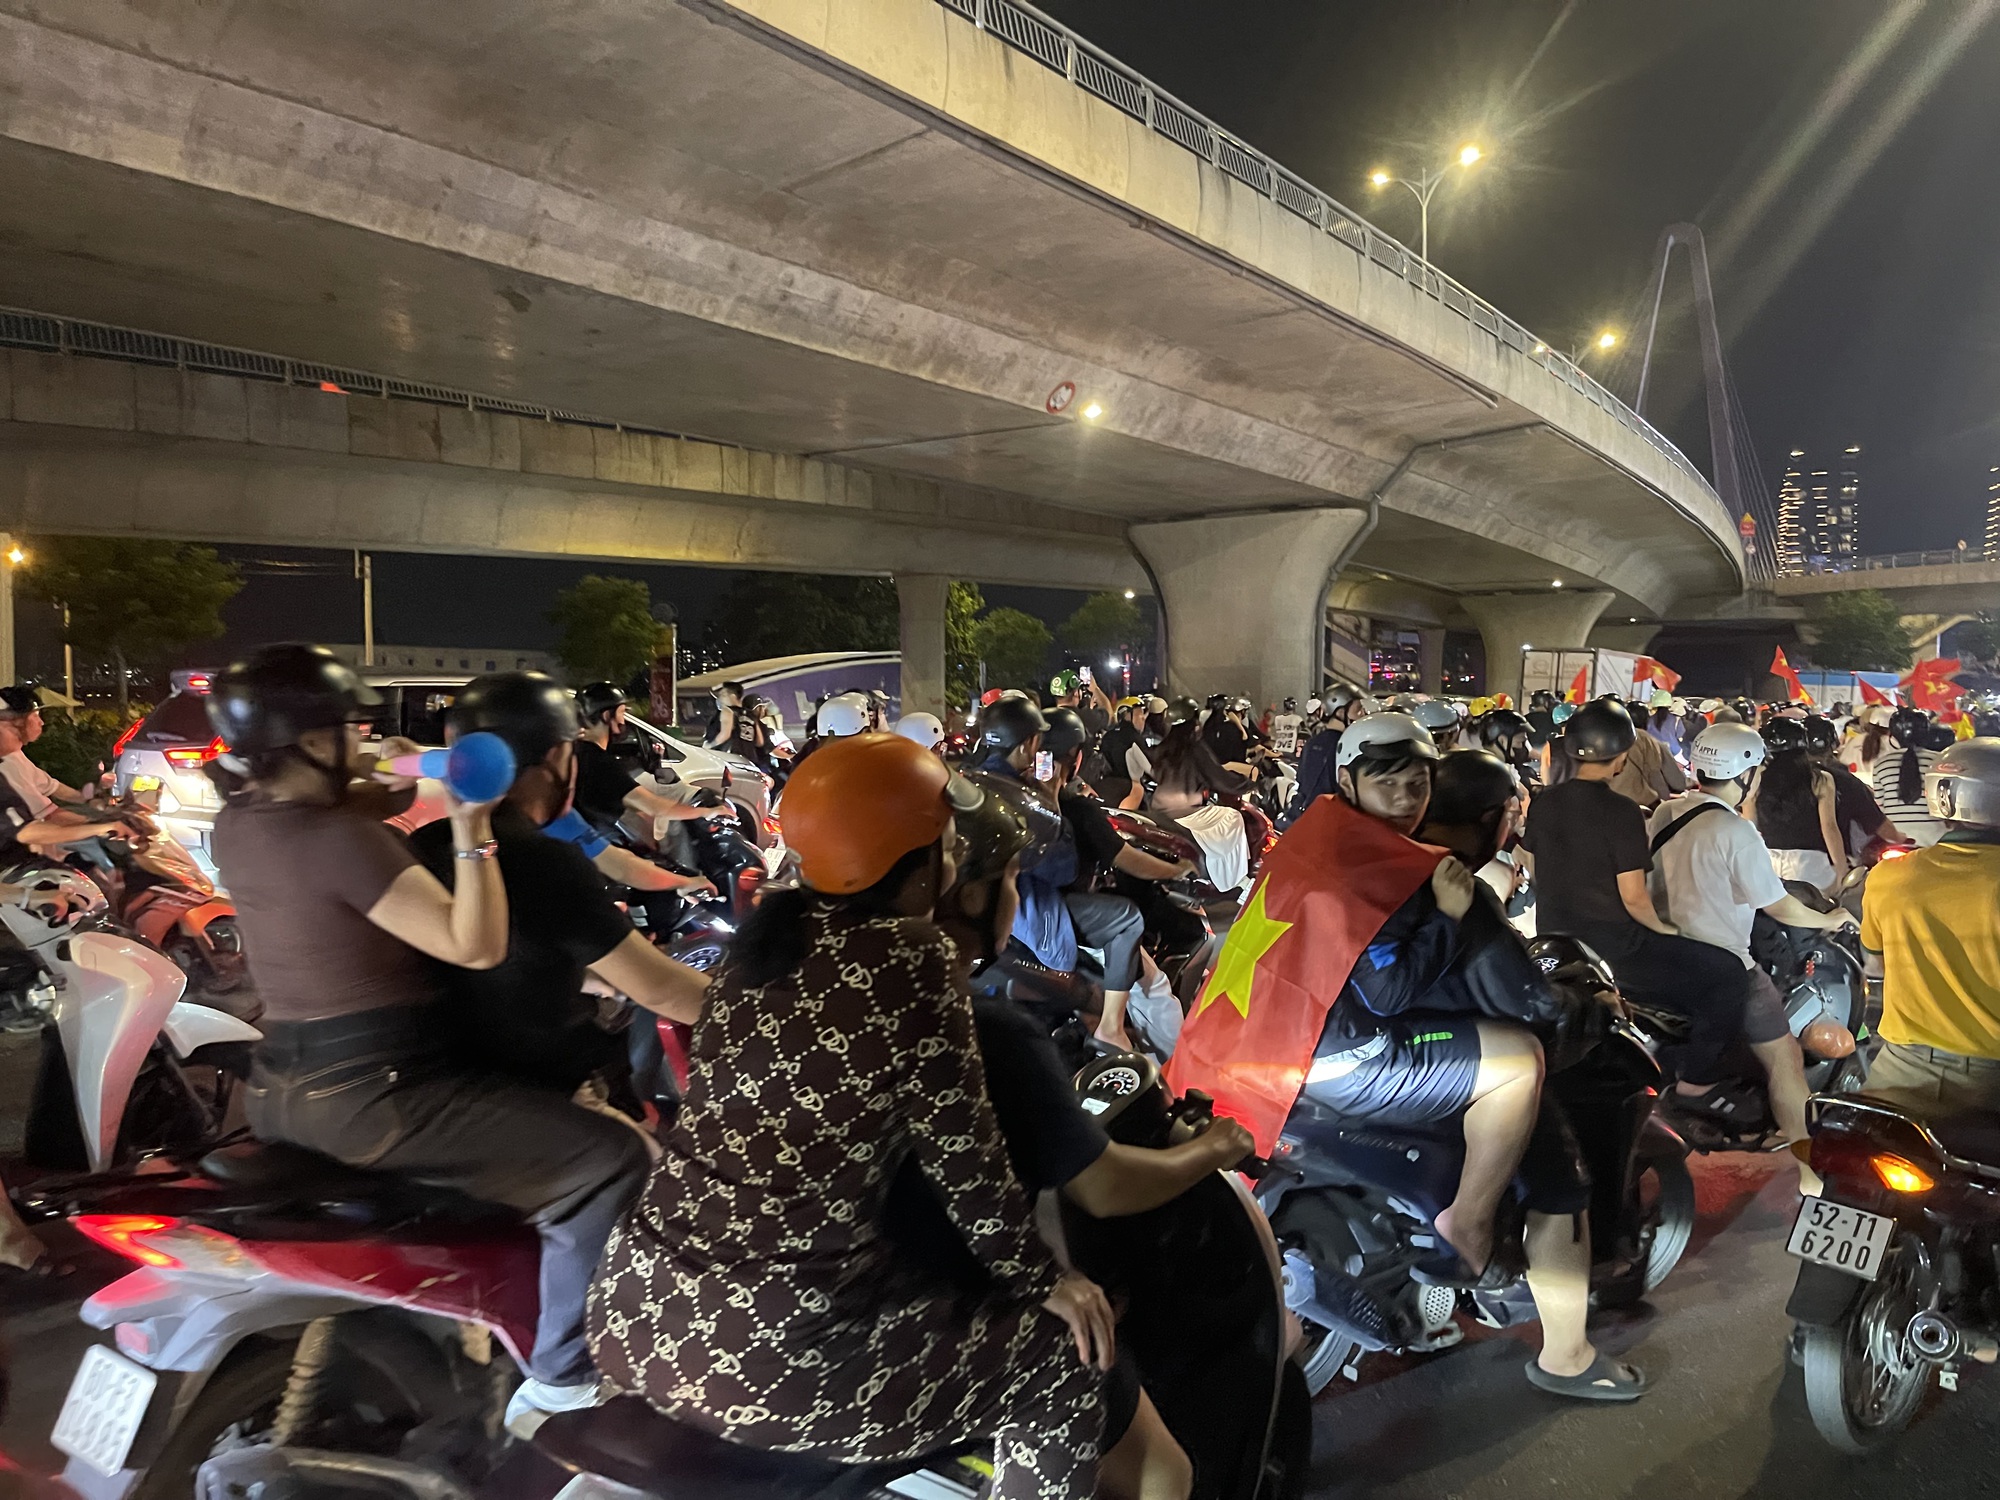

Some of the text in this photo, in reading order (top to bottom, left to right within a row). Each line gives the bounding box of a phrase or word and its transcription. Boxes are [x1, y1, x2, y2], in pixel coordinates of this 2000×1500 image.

[794, 999, 824, 1013] Den
[864, 1014, 899, 1031] Den
[769, 1060, 801, 1074] Den
[1809, 1201, 1878, 1242] 52-T1
[1800, 1230, 1871, 1270] 6200
